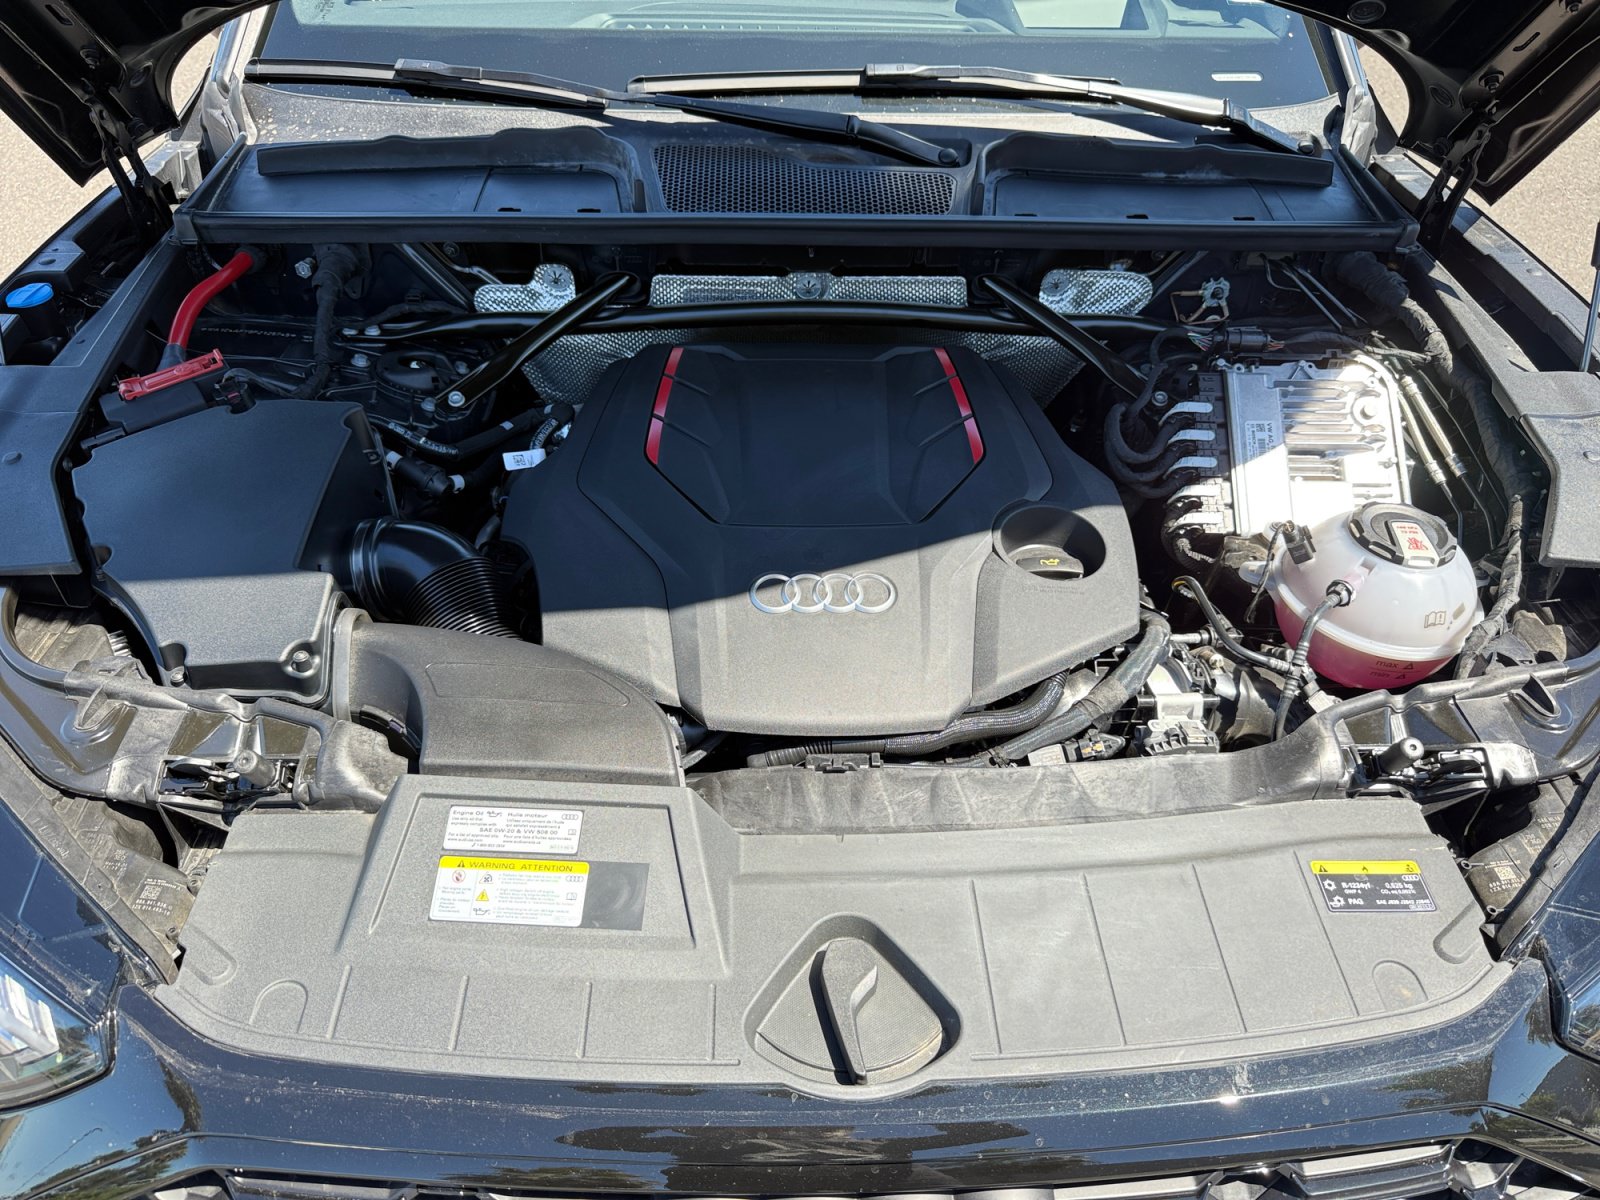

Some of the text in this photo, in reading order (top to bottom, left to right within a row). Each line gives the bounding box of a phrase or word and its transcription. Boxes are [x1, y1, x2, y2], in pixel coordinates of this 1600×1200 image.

[1376, 660, 1398, 668] max
[469, 861, 573, 872] WARNING ATTENTION
